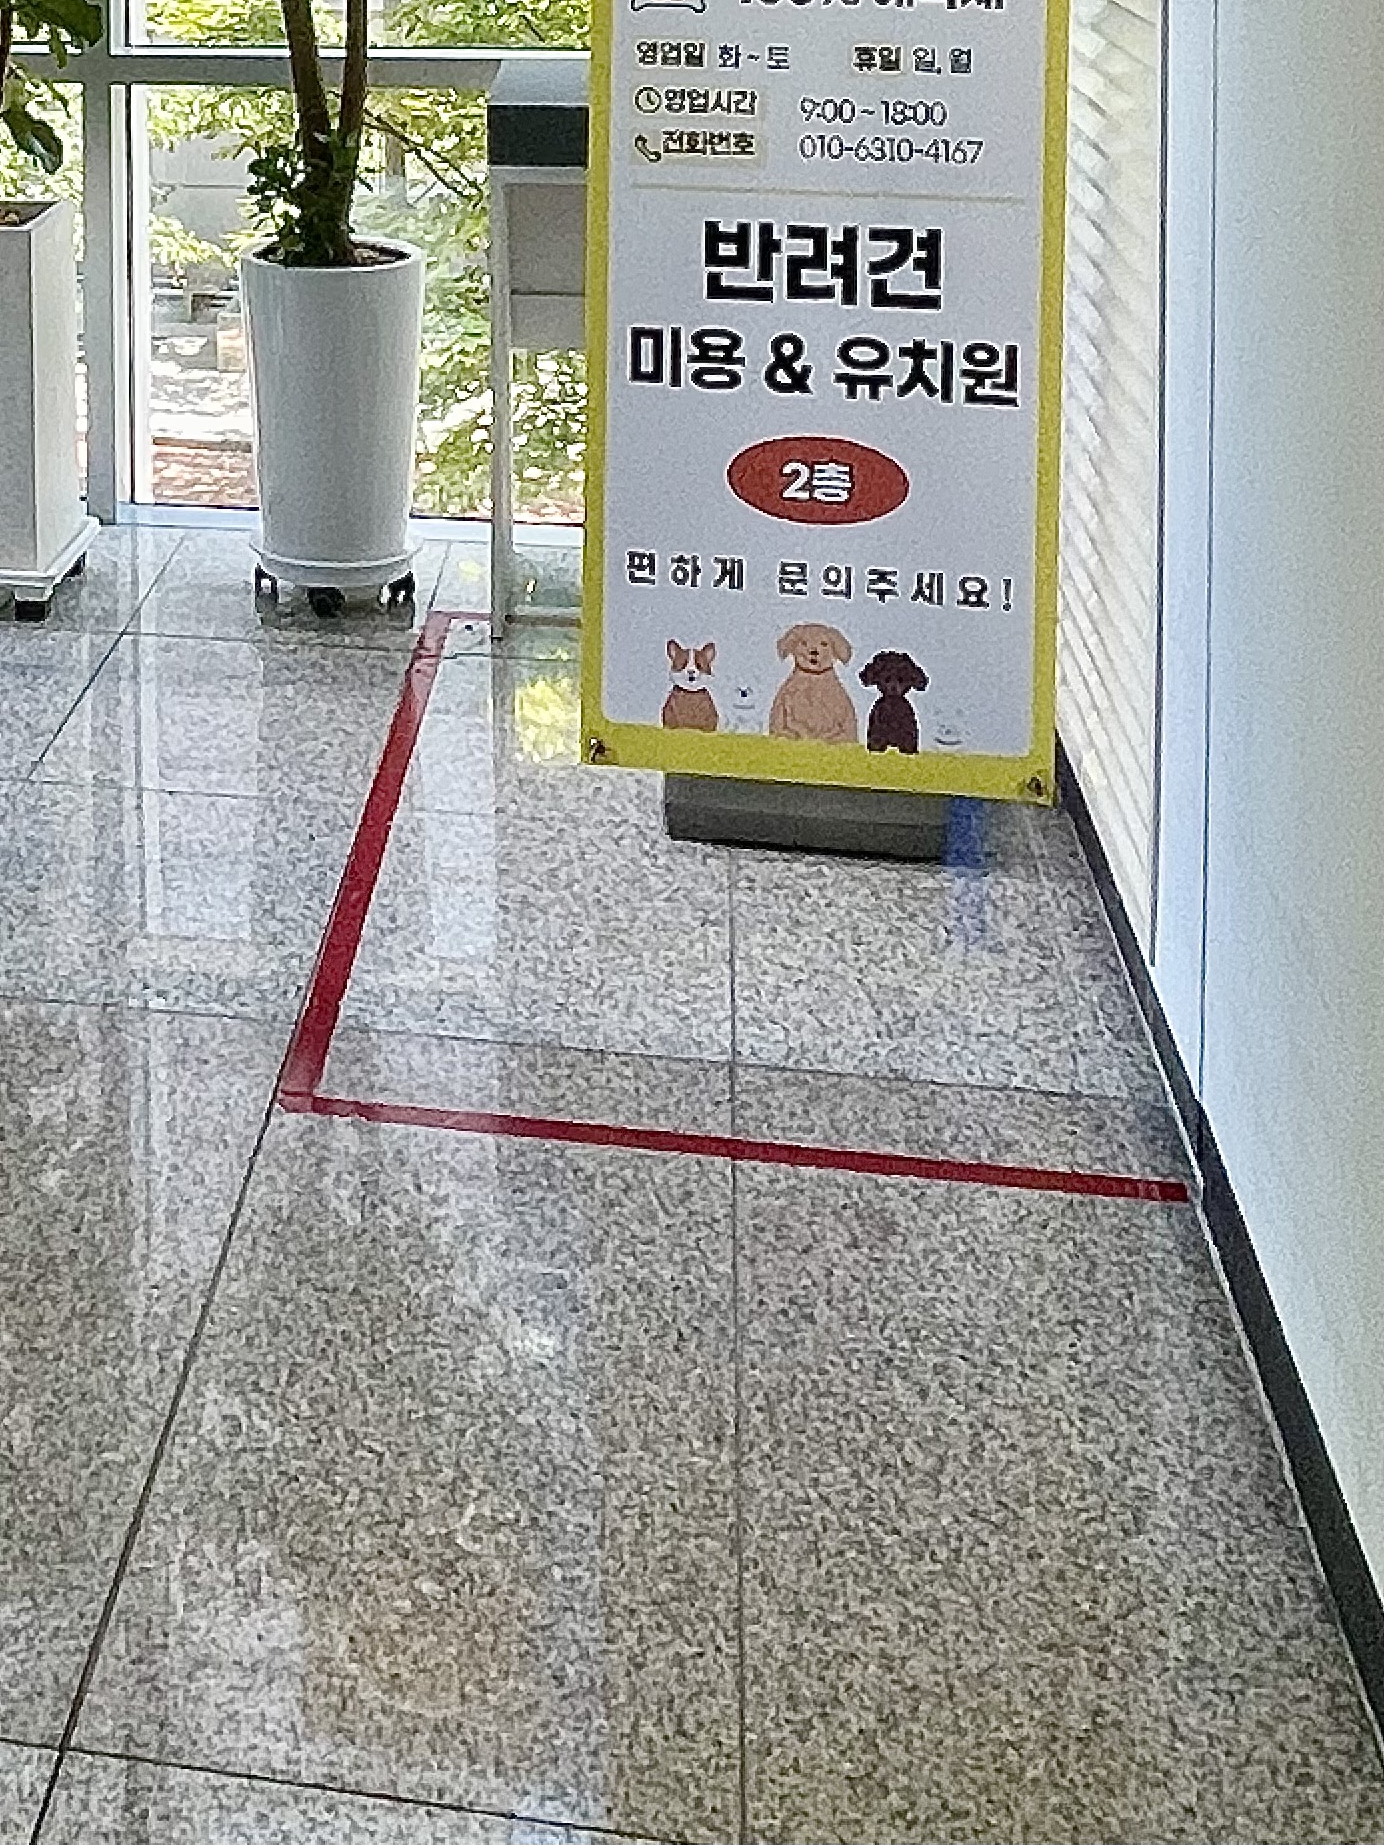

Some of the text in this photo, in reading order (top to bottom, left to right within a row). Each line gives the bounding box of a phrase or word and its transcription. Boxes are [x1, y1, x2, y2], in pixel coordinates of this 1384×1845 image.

[635, 40, 707, 69] 영업일
[718, 42, 741, 70] 화
[766, 45, 791, 71] 토
[852, 45, 903, 74] 휴일
[663, 87, 758, 117] 영업시간
[798, 96, 856, 124] 9:00
[880, 99, 948, 127] 18:00
[661, 128, 757, 157] 전화번호
[797, 133, 984, 165] 010-6310-4167
[702, 219, 943, 311] 반려견
[627, 324, 1020, 408] 미용 & 유치원
[779, 460, 853, 504] 2층
[625, 550, 1013, 612] 편하게 문의주세요!
